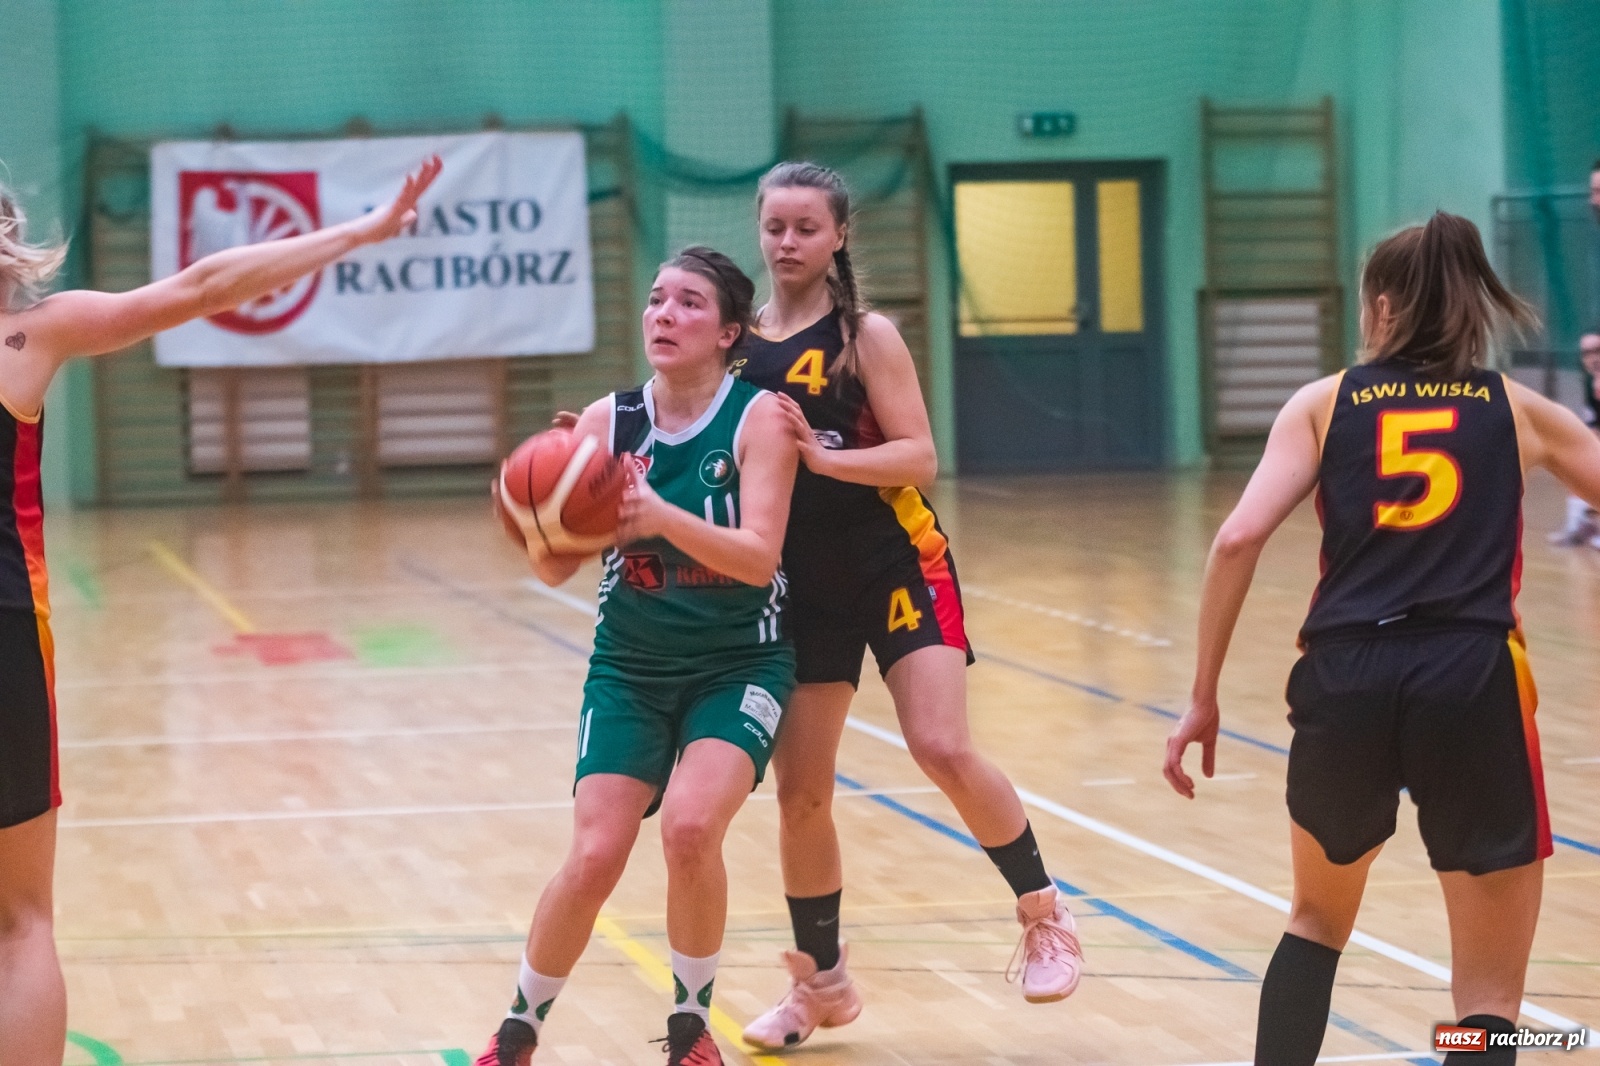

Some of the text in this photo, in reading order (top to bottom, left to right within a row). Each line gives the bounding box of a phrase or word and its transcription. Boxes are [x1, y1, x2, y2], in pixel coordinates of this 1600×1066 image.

[362, 198, 542, 238] ASTO
[335, 243, 576, 295] RACIBÓRZ
[785, 348, 829, 396] 4
[1352, 381, 1491, 406] ISWJ WISŁA
[1374, 406, 1463, 532] 5
[887, 586, 922, 633] 4
